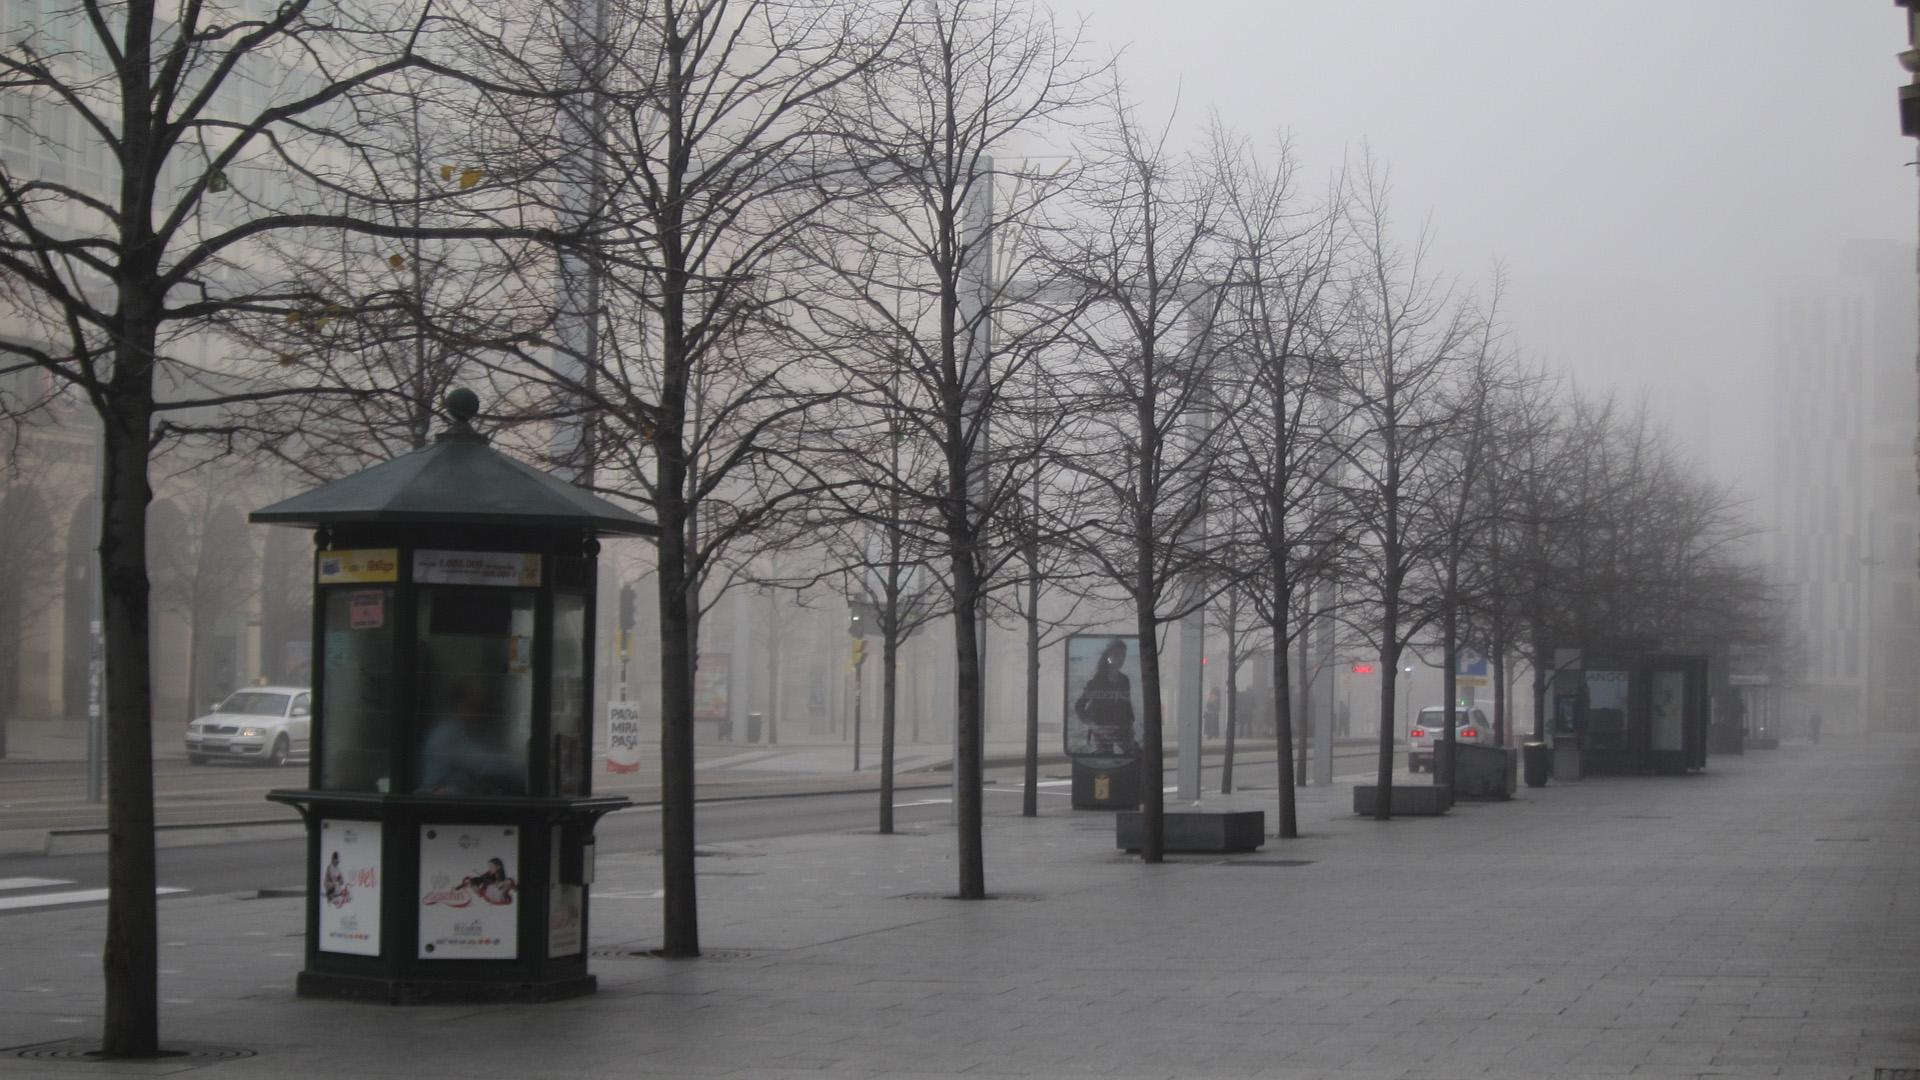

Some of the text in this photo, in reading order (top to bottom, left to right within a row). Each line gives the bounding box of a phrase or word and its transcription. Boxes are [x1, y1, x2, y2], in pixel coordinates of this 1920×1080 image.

[1586, 672, 1625, 681] ANGO
[611, 709, 638, 720] PARA
[611, 722, 638, 733] MIRA
[611, 735, 638, 746] PASA
